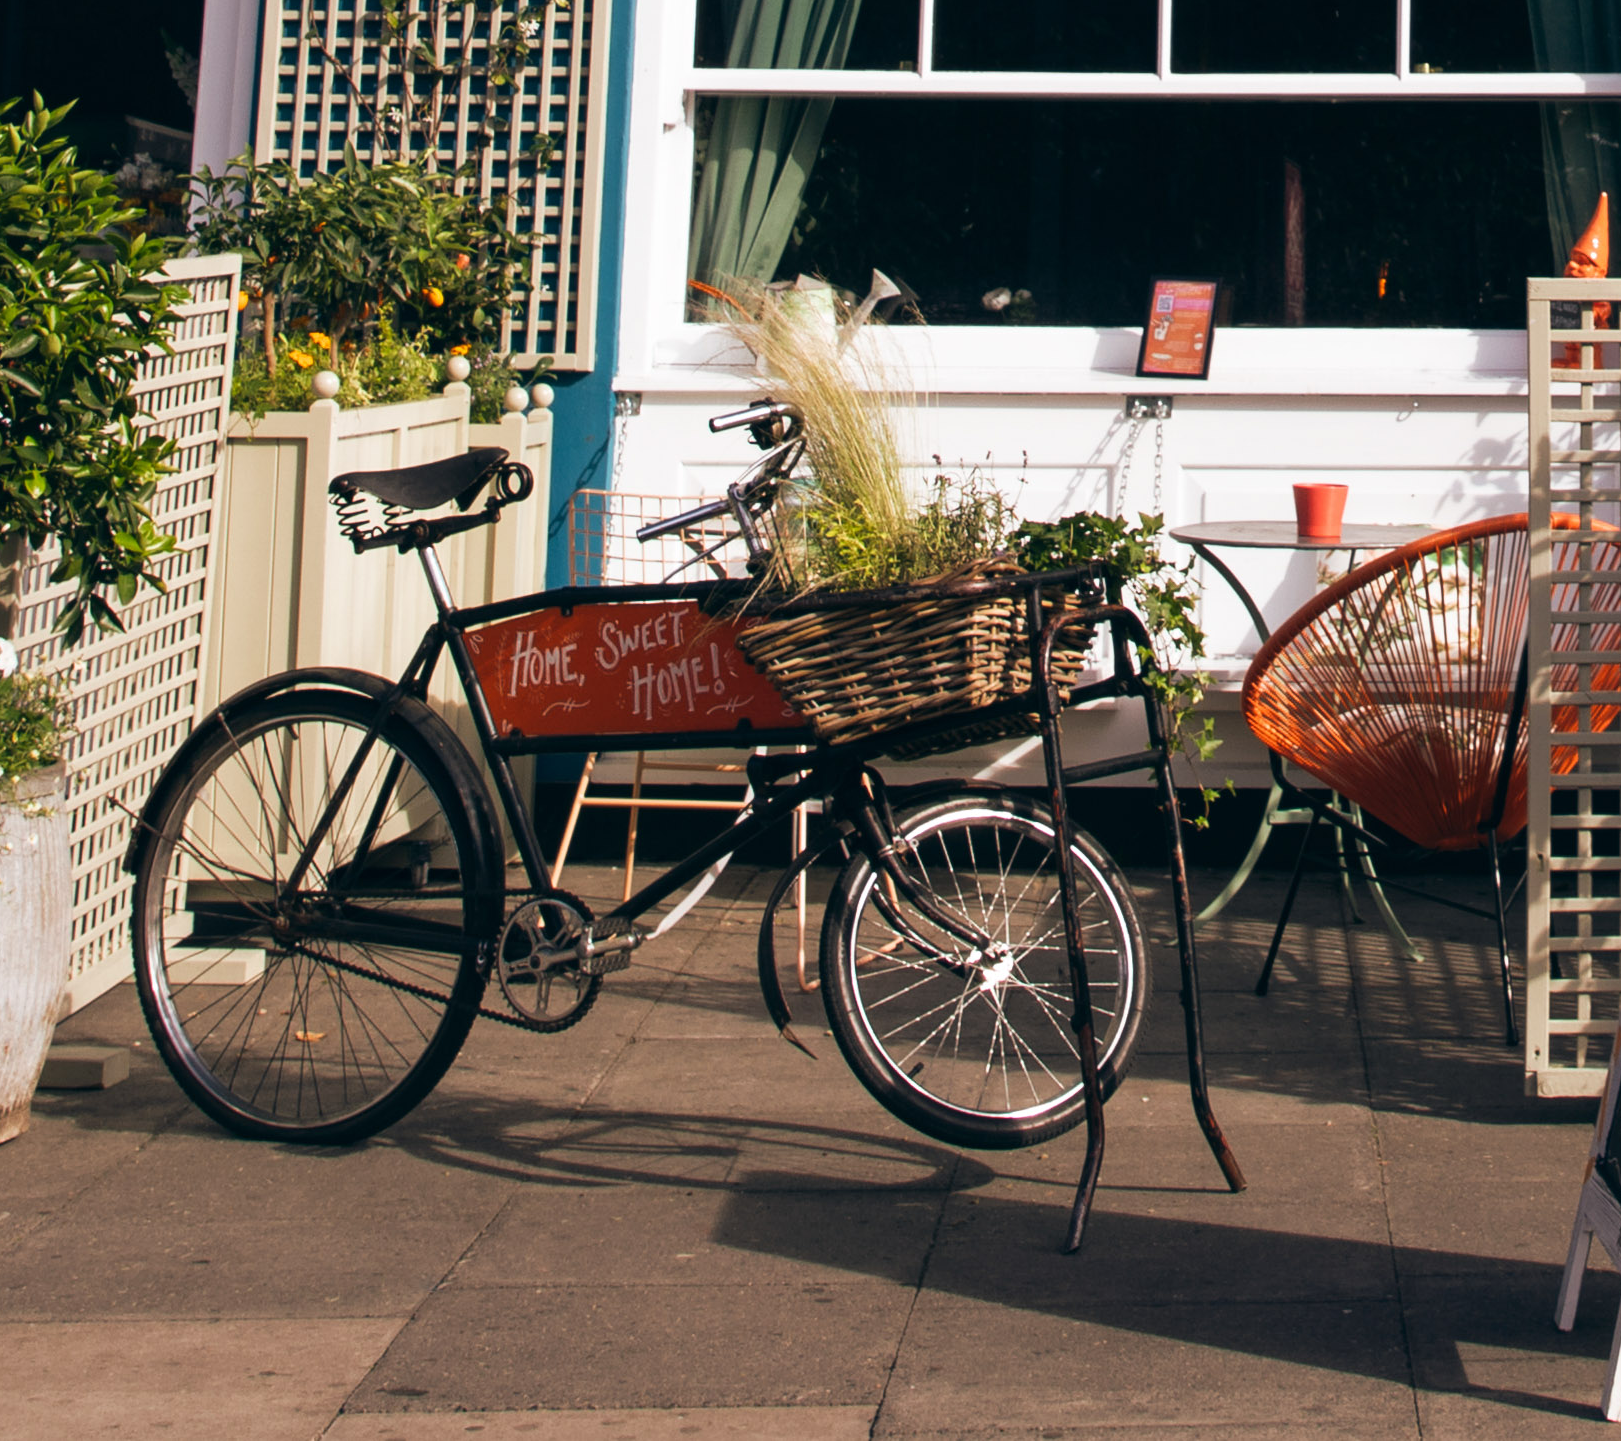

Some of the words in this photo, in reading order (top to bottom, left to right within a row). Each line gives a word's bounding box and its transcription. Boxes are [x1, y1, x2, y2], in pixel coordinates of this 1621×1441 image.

[509, 631, 585, 697] HOME,
[595, 608, 689, 670] SWEET
[631, 642, 725, 720] HOME!
